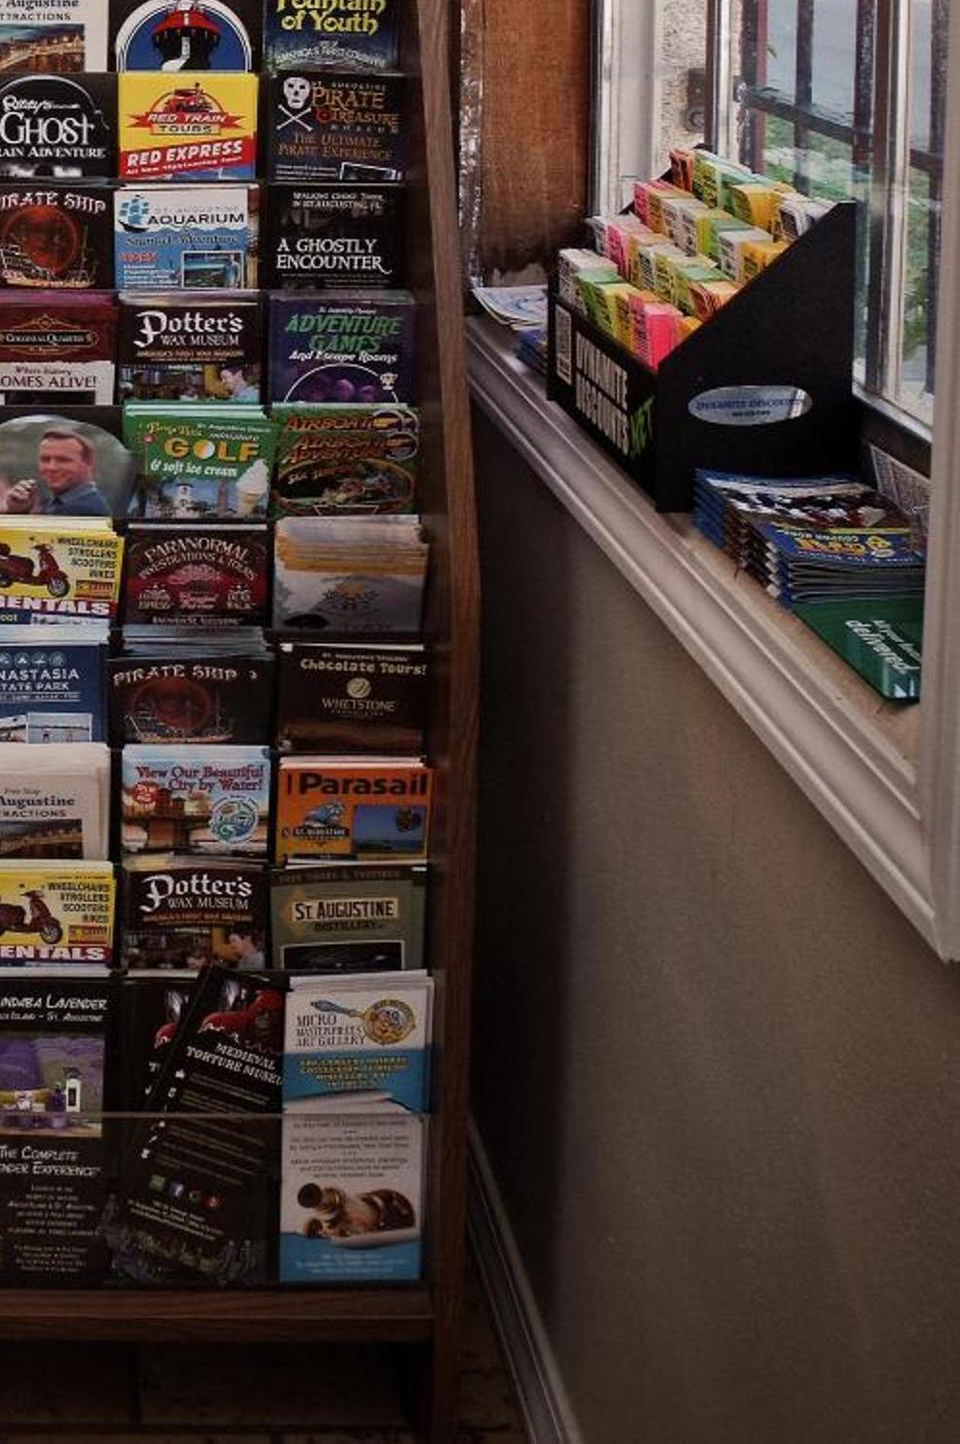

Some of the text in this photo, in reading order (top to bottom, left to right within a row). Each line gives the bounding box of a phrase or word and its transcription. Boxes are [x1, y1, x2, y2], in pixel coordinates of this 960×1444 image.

[281, 10, 379, 36] of Youth
[311, 87, 385, 109] PIRATE
[147, 113, 227, 124] RED TRAIN
[127, 140, 243, 167] RED EXPRESS
[64, 192, 106, 214] SHIP
[148, 214, 245, 226] AQUARIUM
[277, 238, 377, 253] A GHOSTLY
[276, 254, 392, 274] ENCOUNTER
[133, 311, 243, 348] Potter's
[285, 314, 401, 334] ADVENTURE
[160, 334, 239, 346] WAX MUSEUM
[309, 335, 383, 352] GAMES
[48, 376, 97, 388] ALIVE!
[164, 437, 260, 462] GOLF
[144, 537, 248, 562] PARANORMAL
[113, 663, 185, 687] PIRATE
[36, 681, 69, 691] PARK
[321, 697, 396, 712] WHETSTONE
[171, 766, 199, 778] Our
[204, 764, 264, 781] Beautiful
[168, 777, 197, 794] City
[199, 778, 215, 793] by
[299, 773, 428, 795] Parasail
[139, 874, 252, 912] Potter's
[167, 897, 248, 910] WAX MUSEUM
[316, 900, 395, 918] AUGUSTINE
[187, 1046, 242, 1072] TORTURE
[243, 1064, 286, 1086] MUSEU
